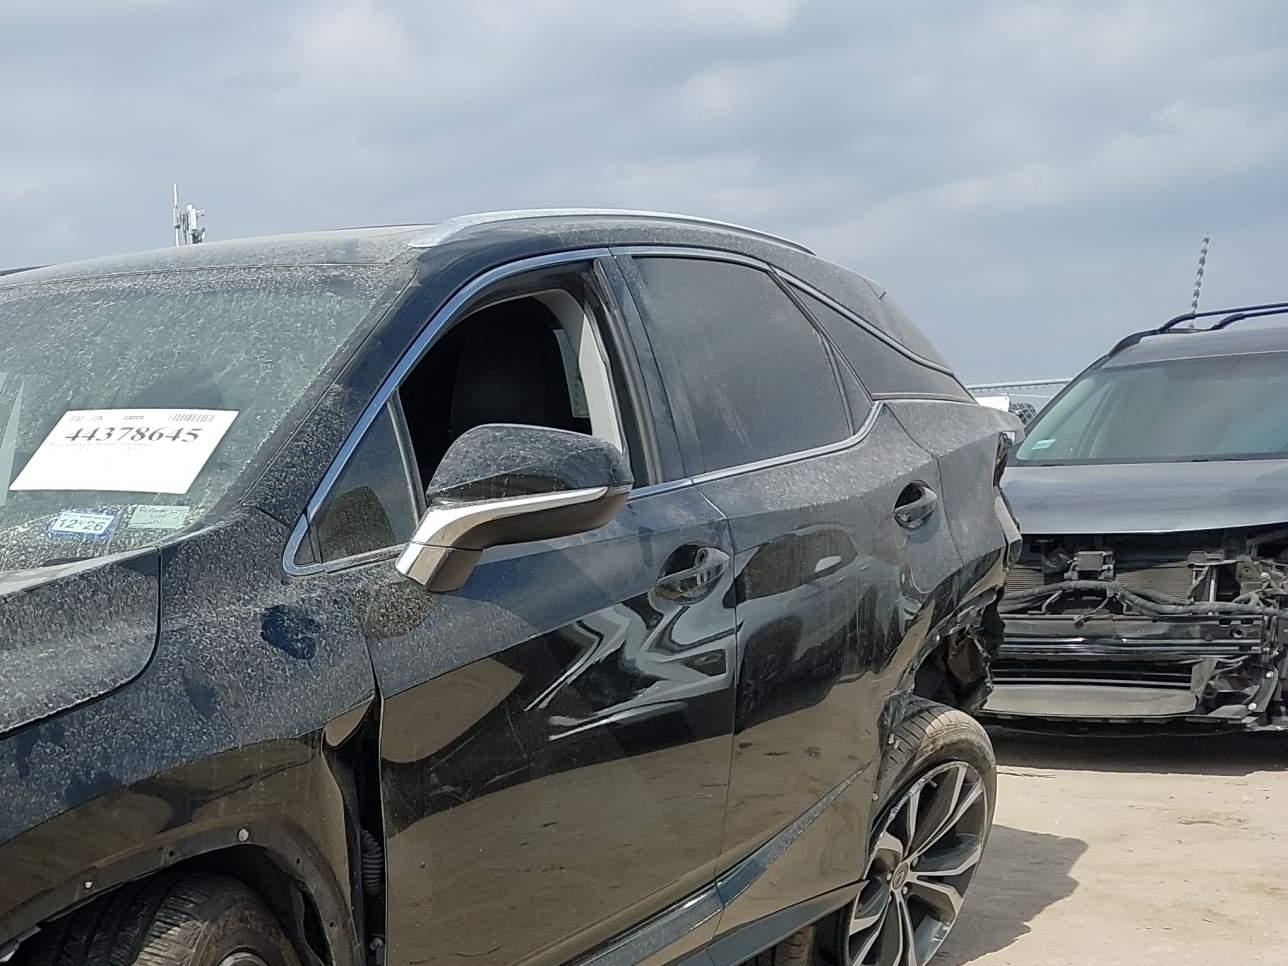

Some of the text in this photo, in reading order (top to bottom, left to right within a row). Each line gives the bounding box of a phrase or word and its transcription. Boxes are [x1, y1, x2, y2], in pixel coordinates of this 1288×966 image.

[65, 427, 203, 442] 44378645
[59, 519, 107, 531] 12 26
